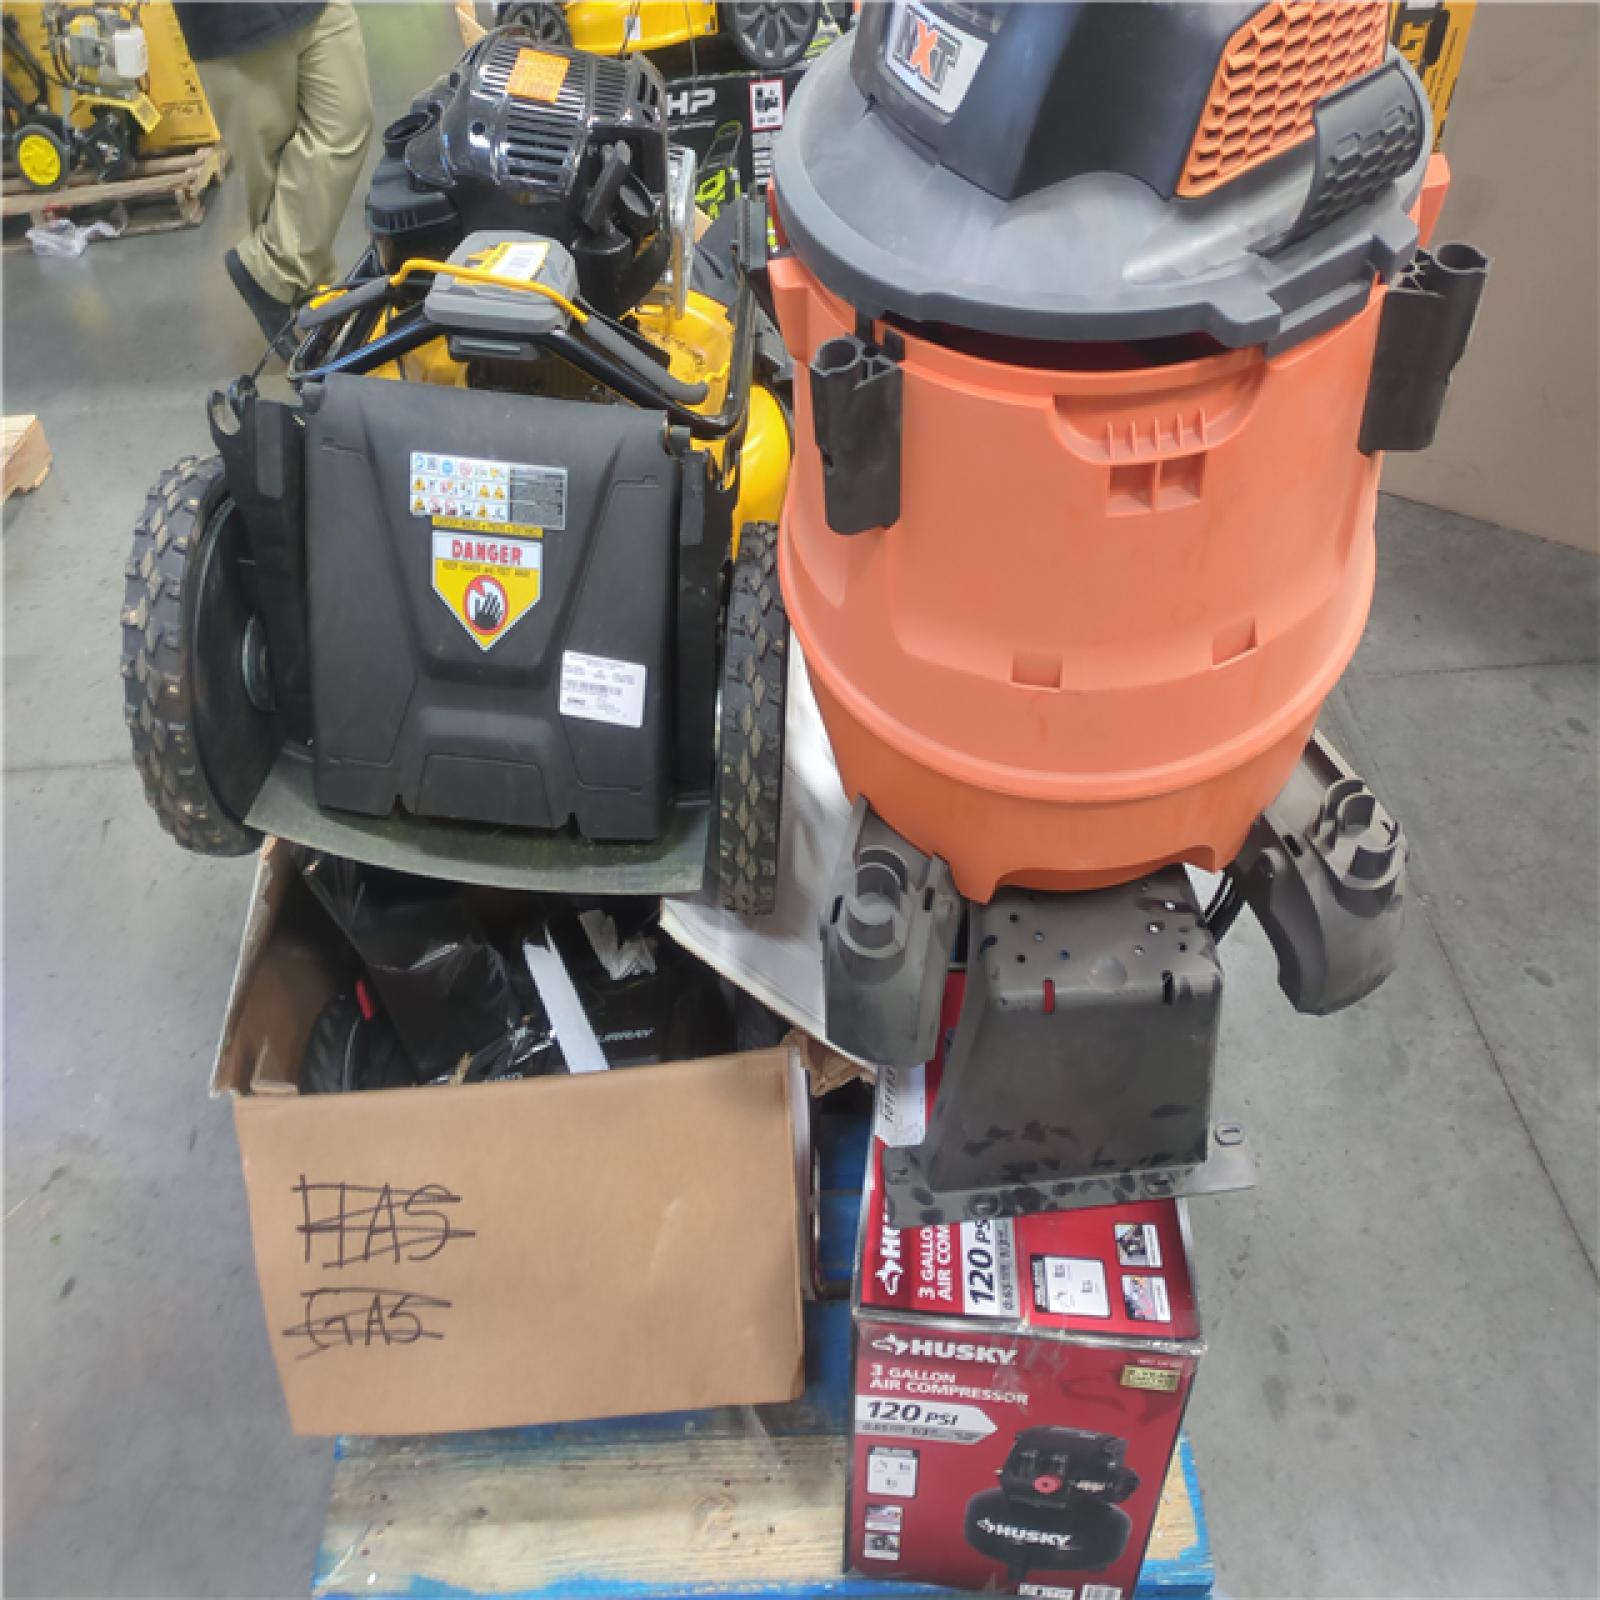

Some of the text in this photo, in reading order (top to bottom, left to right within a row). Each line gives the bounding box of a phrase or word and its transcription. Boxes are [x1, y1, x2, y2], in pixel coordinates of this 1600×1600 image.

[667, 87, 716, 116] HP
[452, 539, 523, 566] DANGER
[917, 1225, 936, 1301] 3 GALLO
[968, 1219, 996, 1305] 120 PS
[937, 1269, 953, 1301] AIR
[910, 1339, 1018, 1366] HUSKY
[870, 1363, 957, 1385] 3 GALLON
[869, 1379, 1029, 1406] AIR COMPRESSOR
[867, 1401, 959, 1427] 120 PSI
[996, 1521, 1073, 1550] HUSKY
